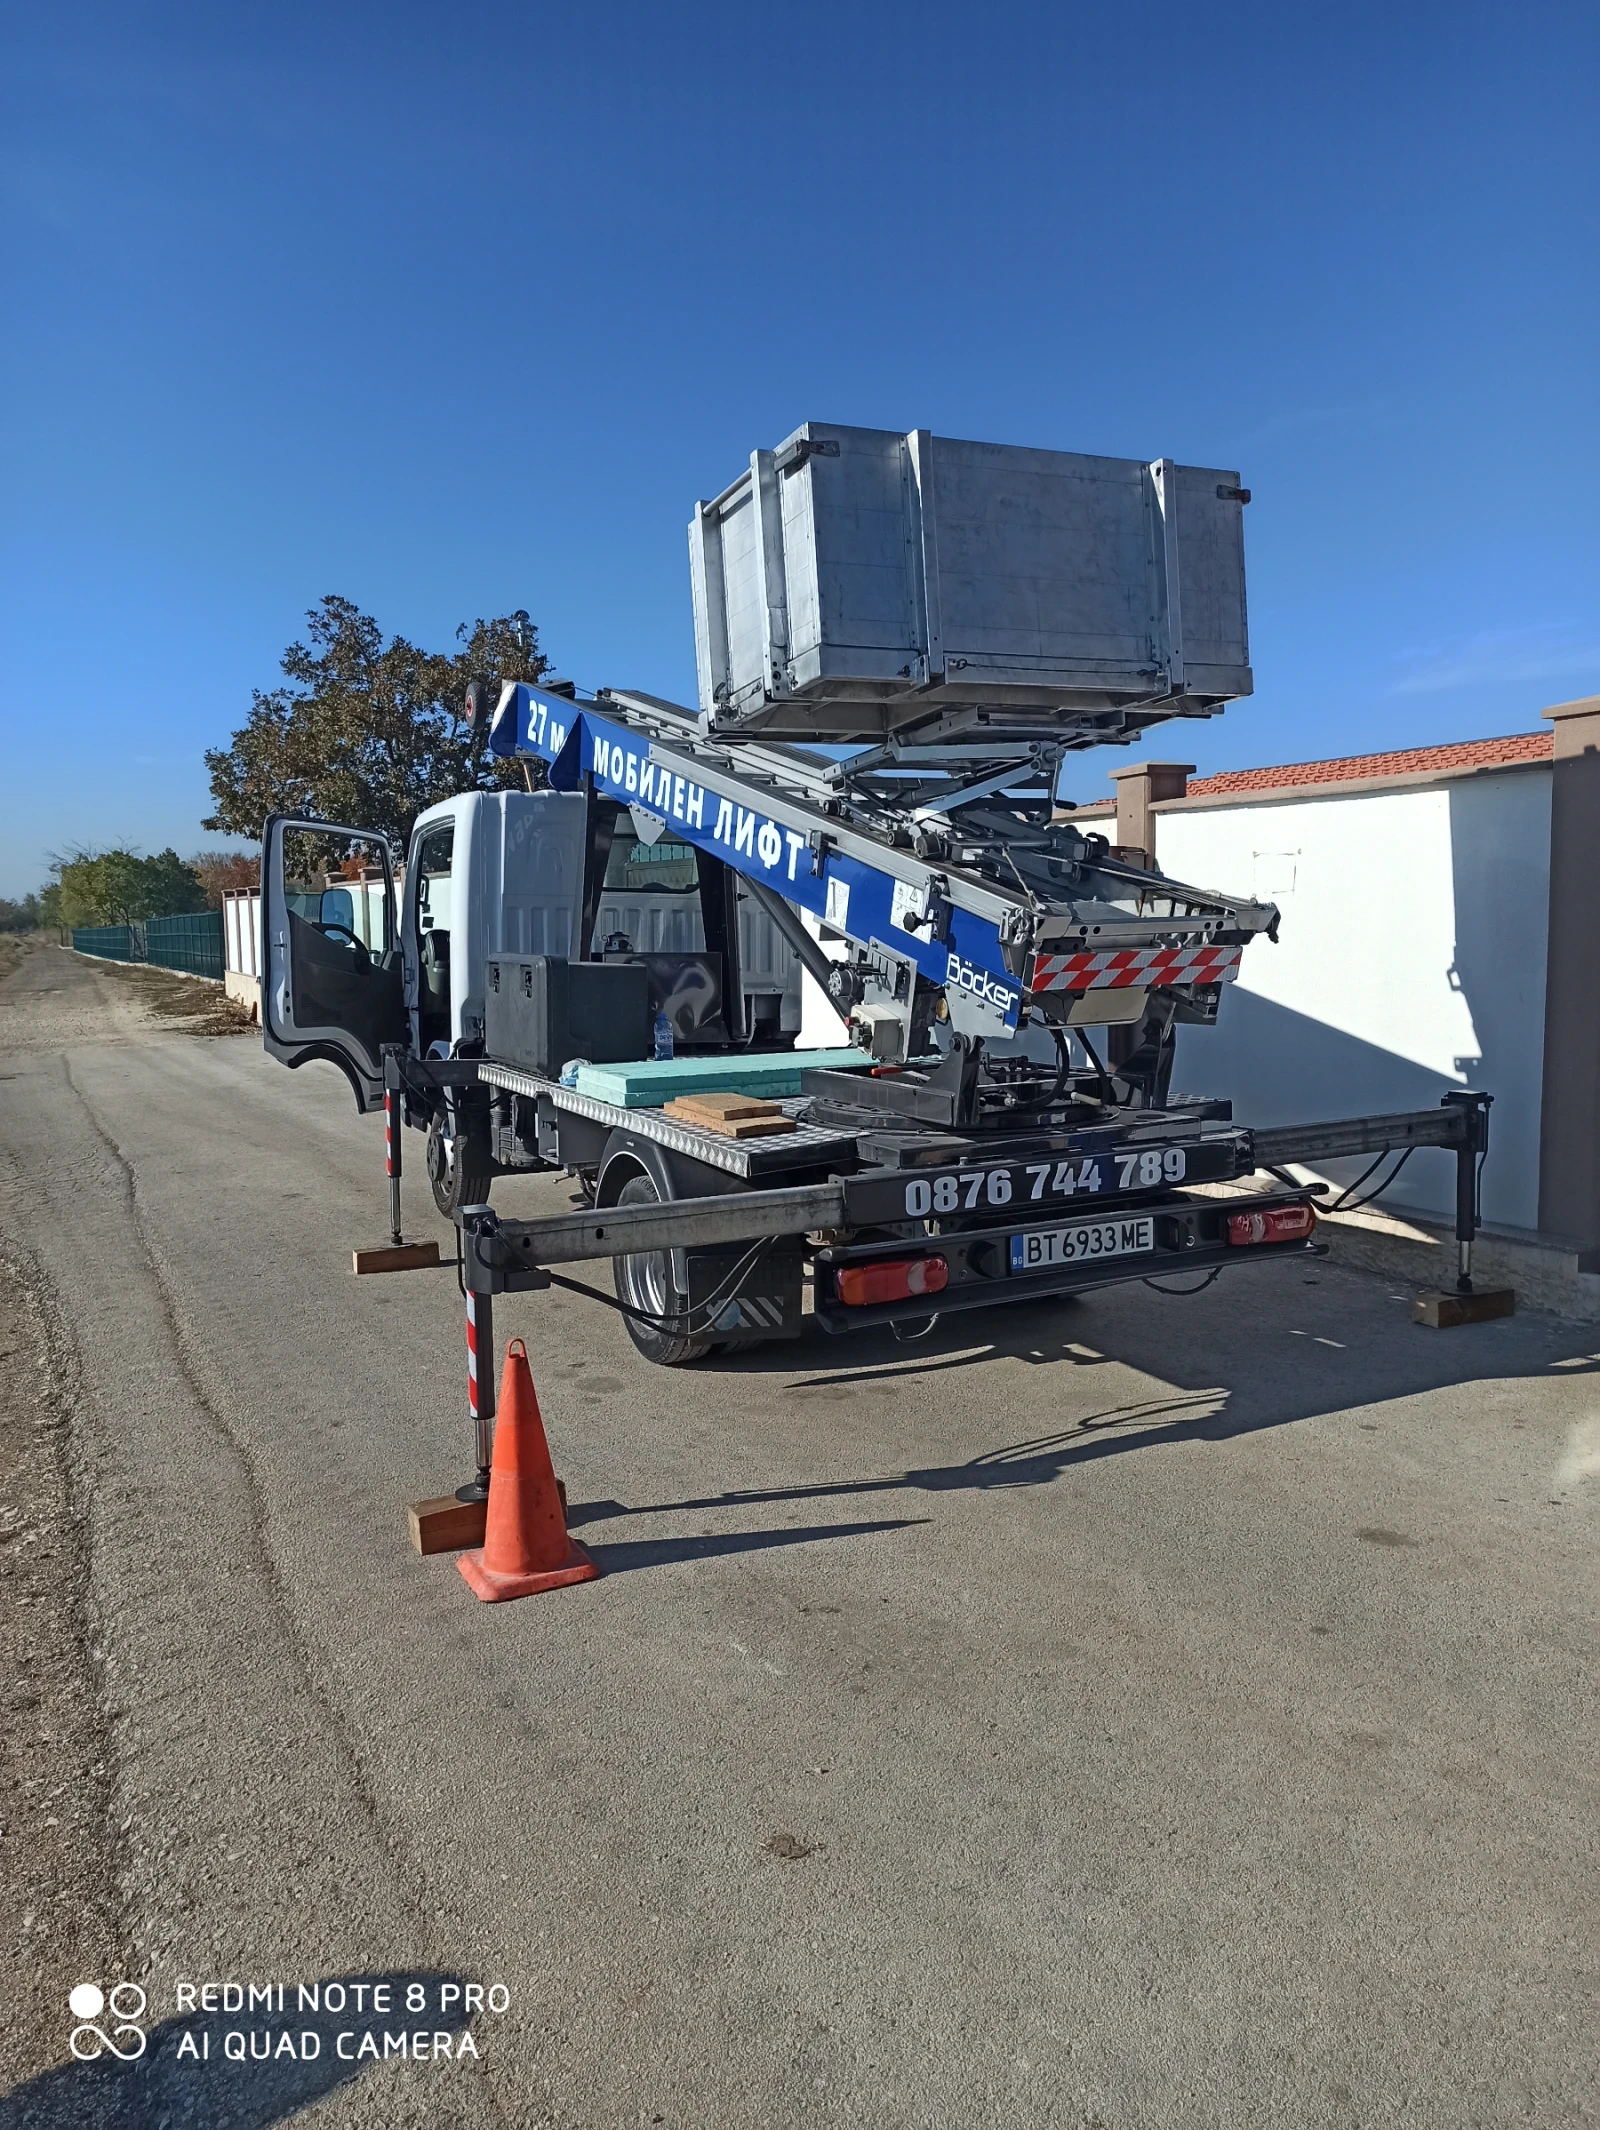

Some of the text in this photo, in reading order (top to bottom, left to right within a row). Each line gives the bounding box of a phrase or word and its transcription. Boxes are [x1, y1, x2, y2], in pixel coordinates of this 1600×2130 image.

[527, 699, 548, 746] 27
[593, 735, 706, 830] МОБИЛЕН
[713, 797, 805, 882] ЛИФТ
[946, 952, 1019, 1011] Böcker
[905, 1148, 1186, 1217] 0876 744 789
[1012, 1256, 1023, 1265] BG
[1027, 1221, 1149, 1264] BT 6933 ME
